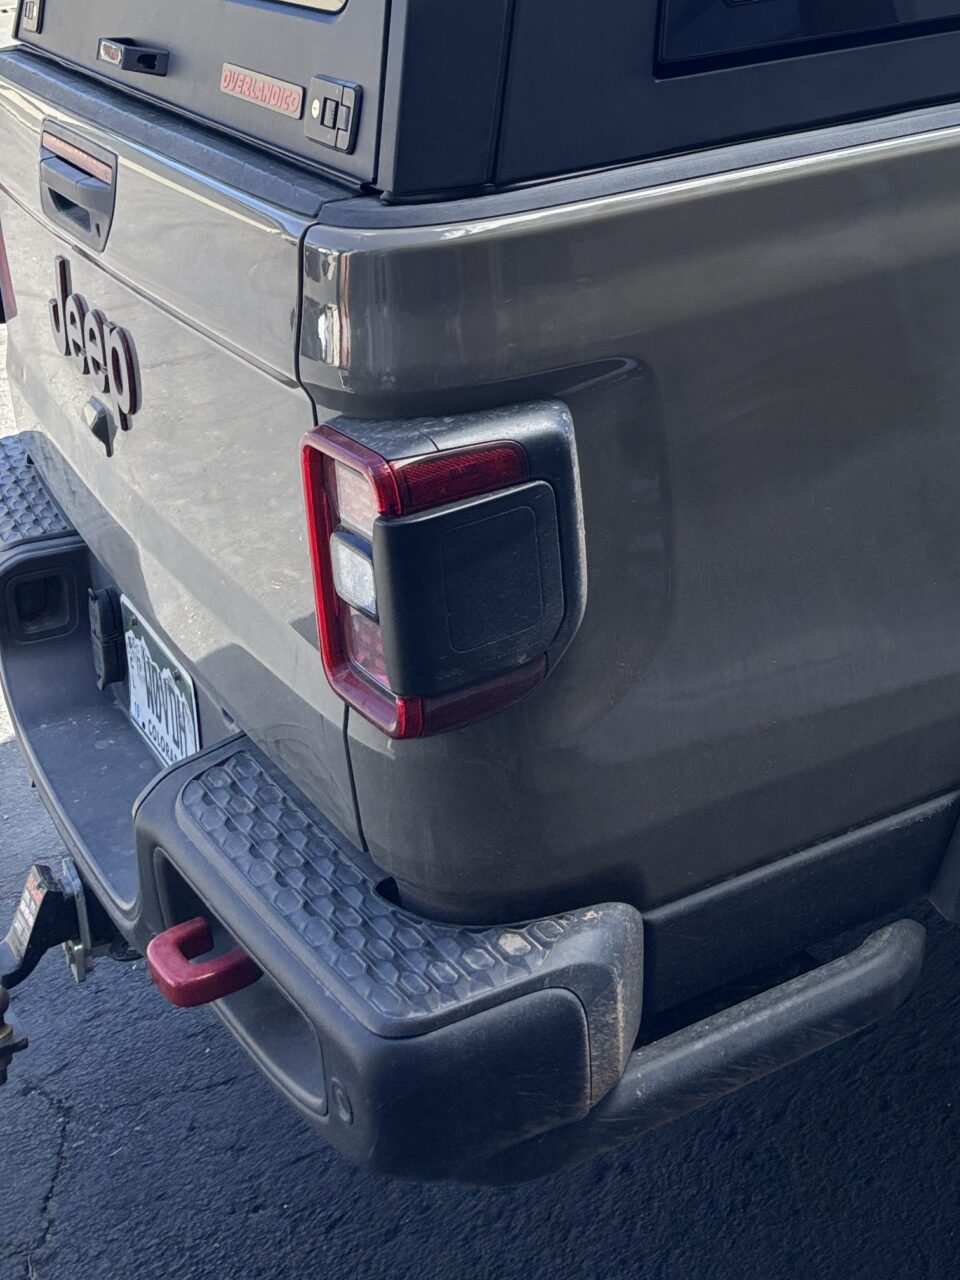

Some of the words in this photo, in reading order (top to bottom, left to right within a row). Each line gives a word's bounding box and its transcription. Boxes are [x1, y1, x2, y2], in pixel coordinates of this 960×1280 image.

[222, 70, 301, 113] OVERLANDICO
[49, 254, 142, 432] Jeep
[147, 718, 178, 762] COLORA
